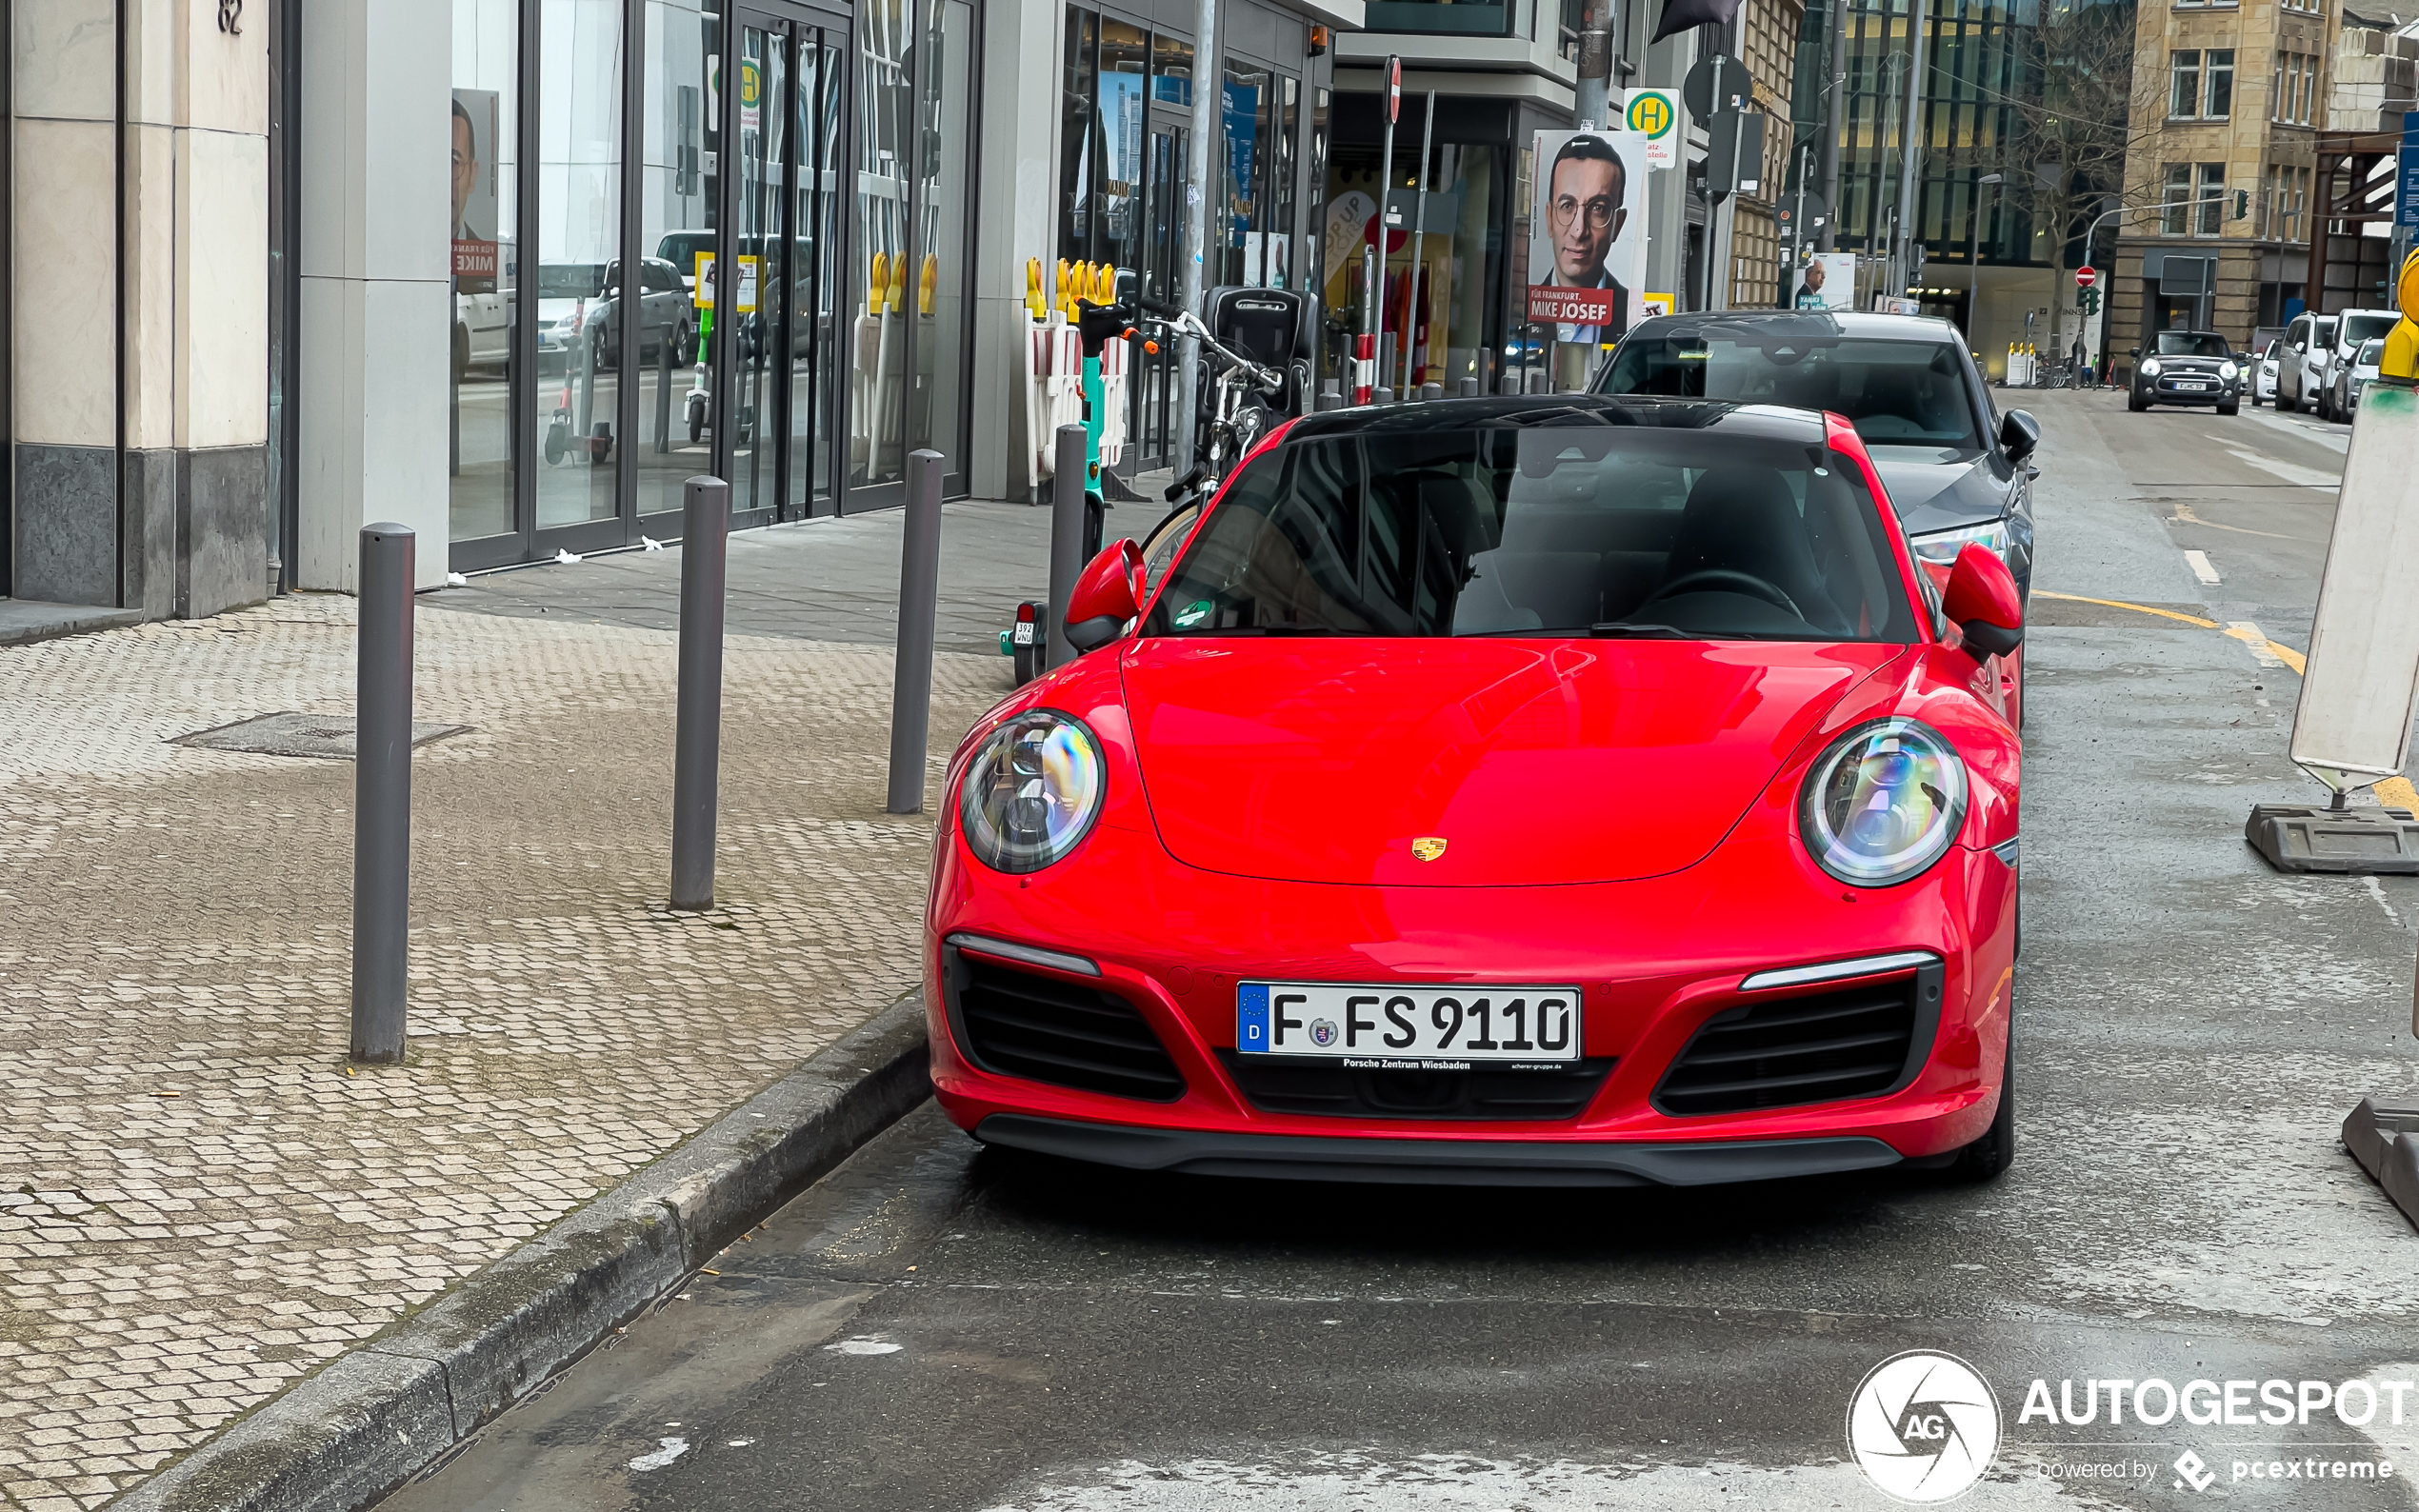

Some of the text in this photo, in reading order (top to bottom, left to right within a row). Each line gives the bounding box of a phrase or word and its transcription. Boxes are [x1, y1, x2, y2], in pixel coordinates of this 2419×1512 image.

[1640, 102, 1660, 129] H
[1339, 196, 1360, 223] UP
[1530, 288, 1582, 301] FÜR FRANKFURT.
[1531, 300, 1608, 321] MIKE JOSEF
[1019, 625, 1031, 633] 392
[1273, 994, 1570, 1051] F FS 9110
[1249, 1025, 1260, 1040] D
[1343, 1058, 1470, 1070] Porsche Zentrum Wiesbaden
